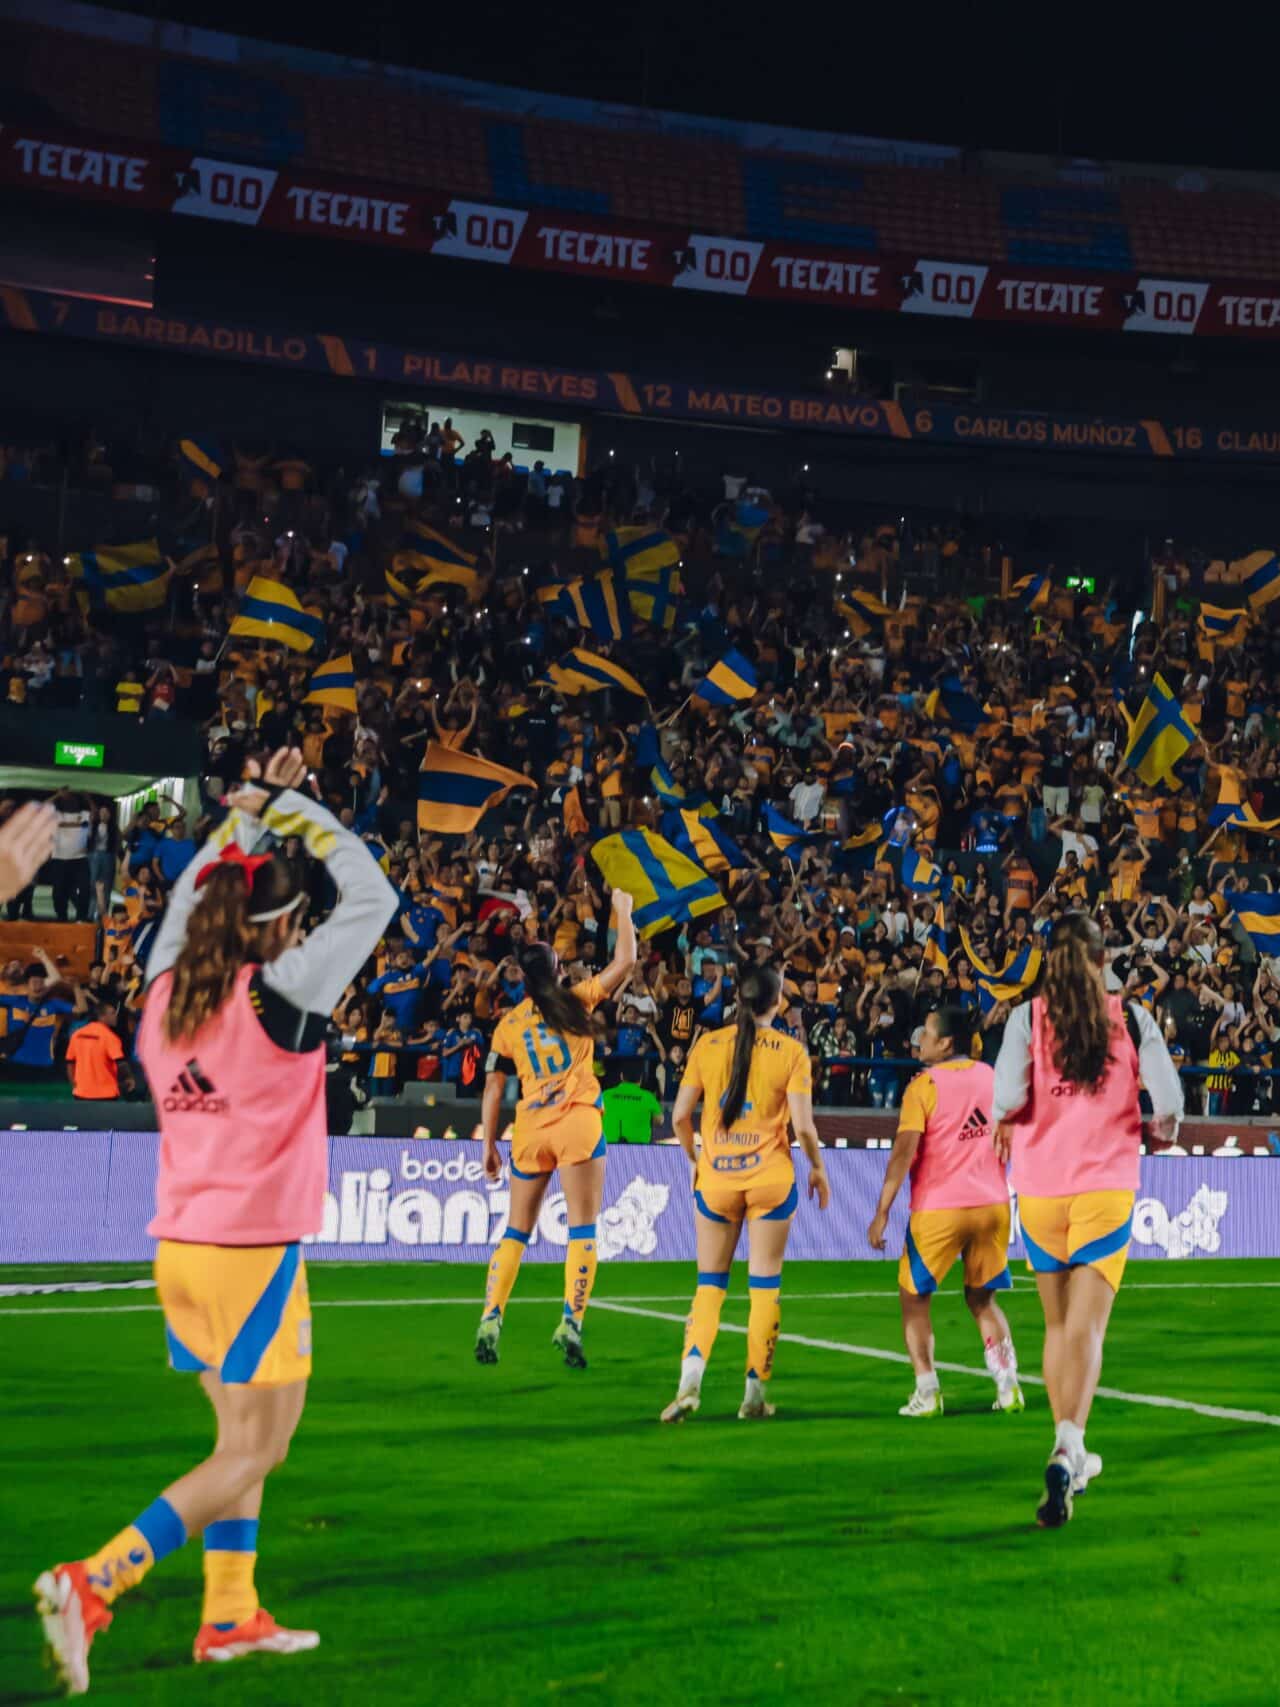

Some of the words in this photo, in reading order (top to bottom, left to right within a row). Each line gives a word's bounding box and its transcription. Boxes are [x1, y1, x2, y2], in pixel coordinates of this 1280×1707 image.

[14, 139, 149, 191] TECATE
[288, 187, 409, 235] TECATE
[537, 227, 651, 270] TECATE
[771, 256, 880, 296] TECATE
[997, 279, 1104, 315] TECATE
[54, 303, 70, 325] 7
[96, 310, 307, 360] BARBADILLO
[364, 349, 377, 371] 1
[403, 355, 491, 385] PILAR
[502, 368, 596, 399] REYES
[642, 384, 671, 407] 12
[688, 391, 783, 417] MATEO
[790, 402, 879, 427] BRAVO
[915, 411, 933, 432] 6
[954, 416, 1046, 441] CARLOS
[1054, 419, 1137, 446] MUÑOZ
[1175, 428, 1203, 448] 16
[522, 1023, 572, 1079] 15
